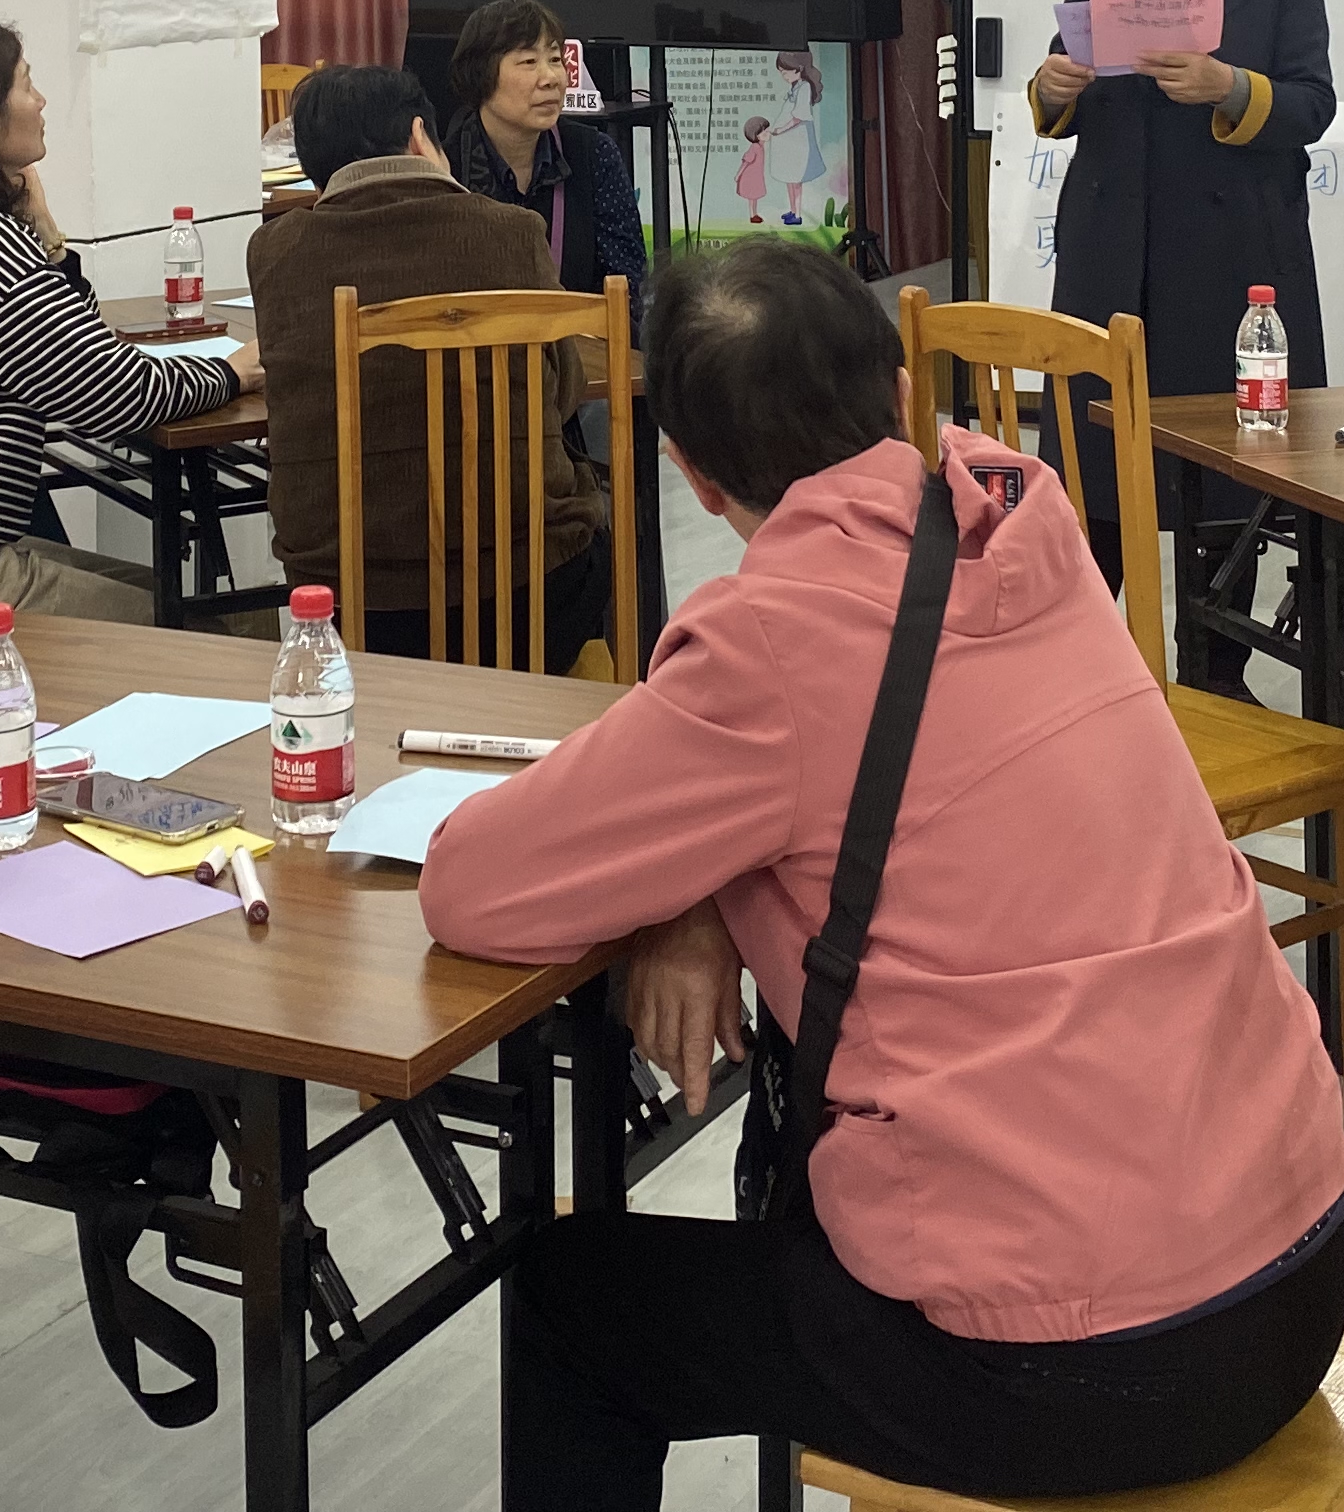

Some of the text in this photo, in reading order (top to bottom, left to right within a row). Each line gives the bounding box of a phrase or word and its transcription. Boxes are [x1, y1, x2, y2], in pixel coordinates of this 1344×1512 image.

[563, 93, 597, 108] 家社区
[273, 756, 317, 776] 农夫山泉
